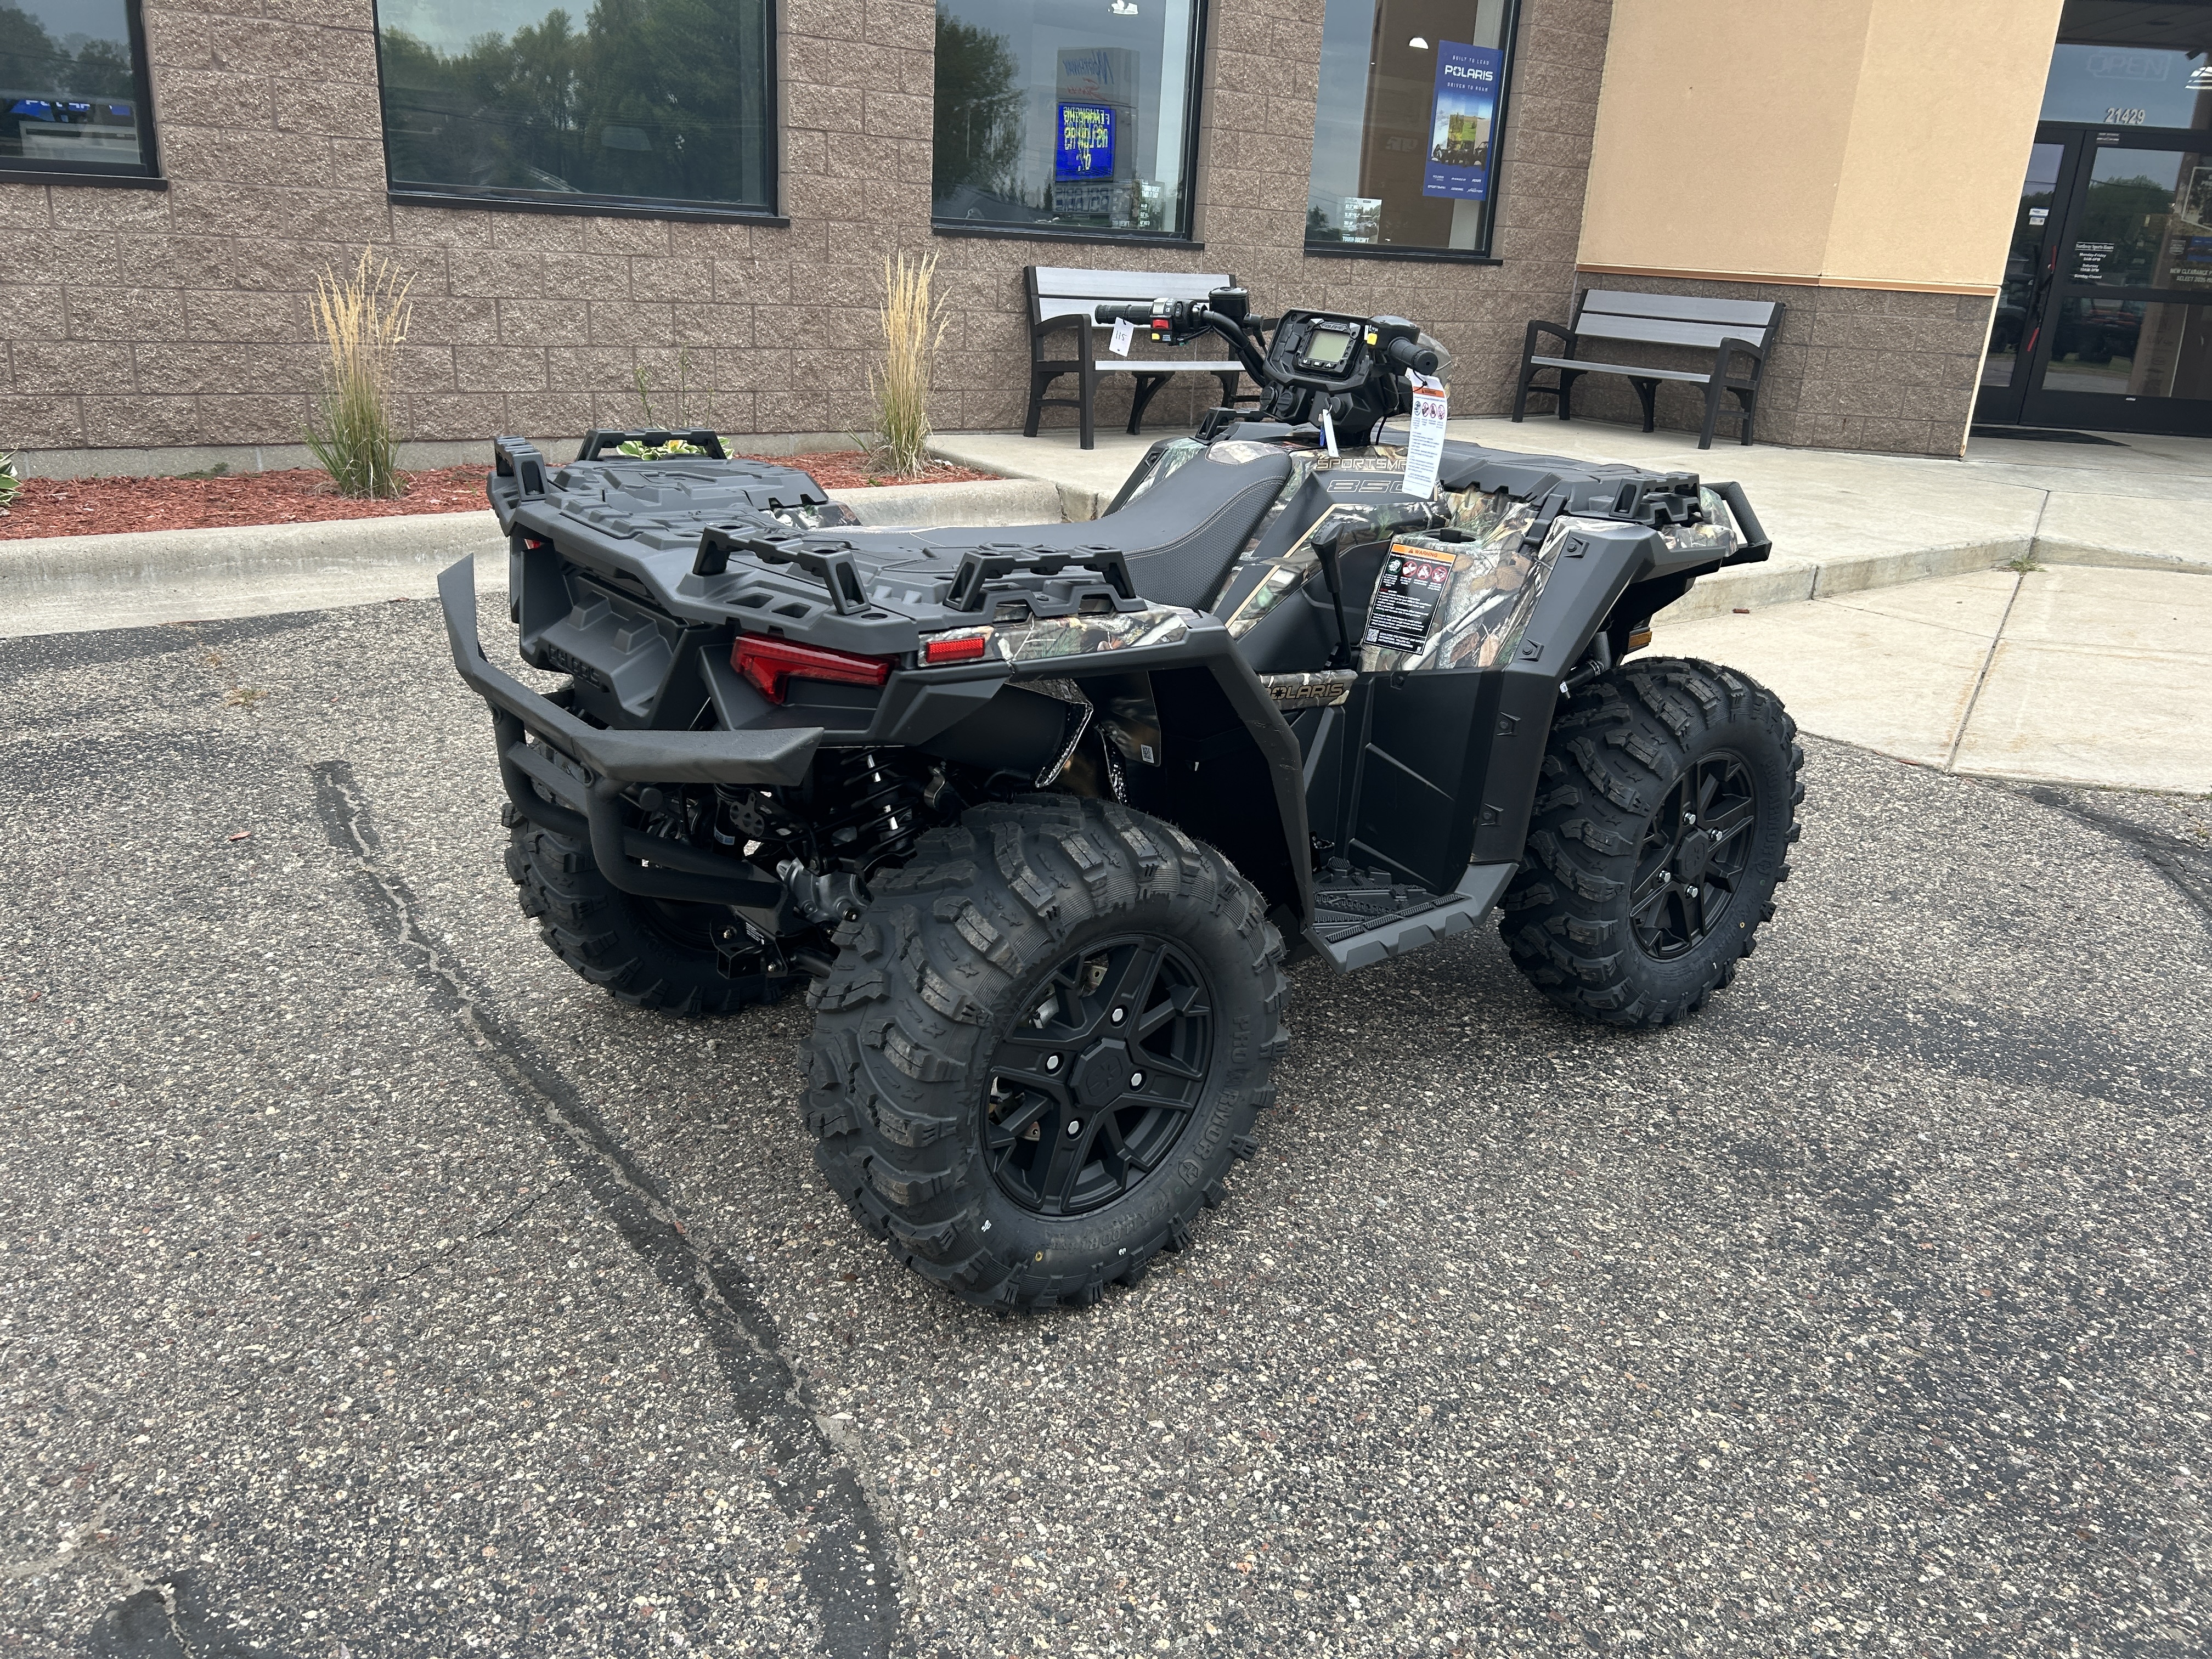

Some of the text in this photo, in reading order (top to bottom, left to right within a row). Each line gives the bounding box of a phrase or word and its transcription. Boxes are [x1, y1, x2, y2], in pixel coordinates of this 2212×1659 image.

[1444, 65, 1493, 81] POLARIS
[2105, 107, 2146, 124] 21429
[1317, 458, 1406, 471] SPORTSMA
[1414, 549, 1438, 558] WARNING
[1193, 1014, 1251, 1160] PRO ARMOR
